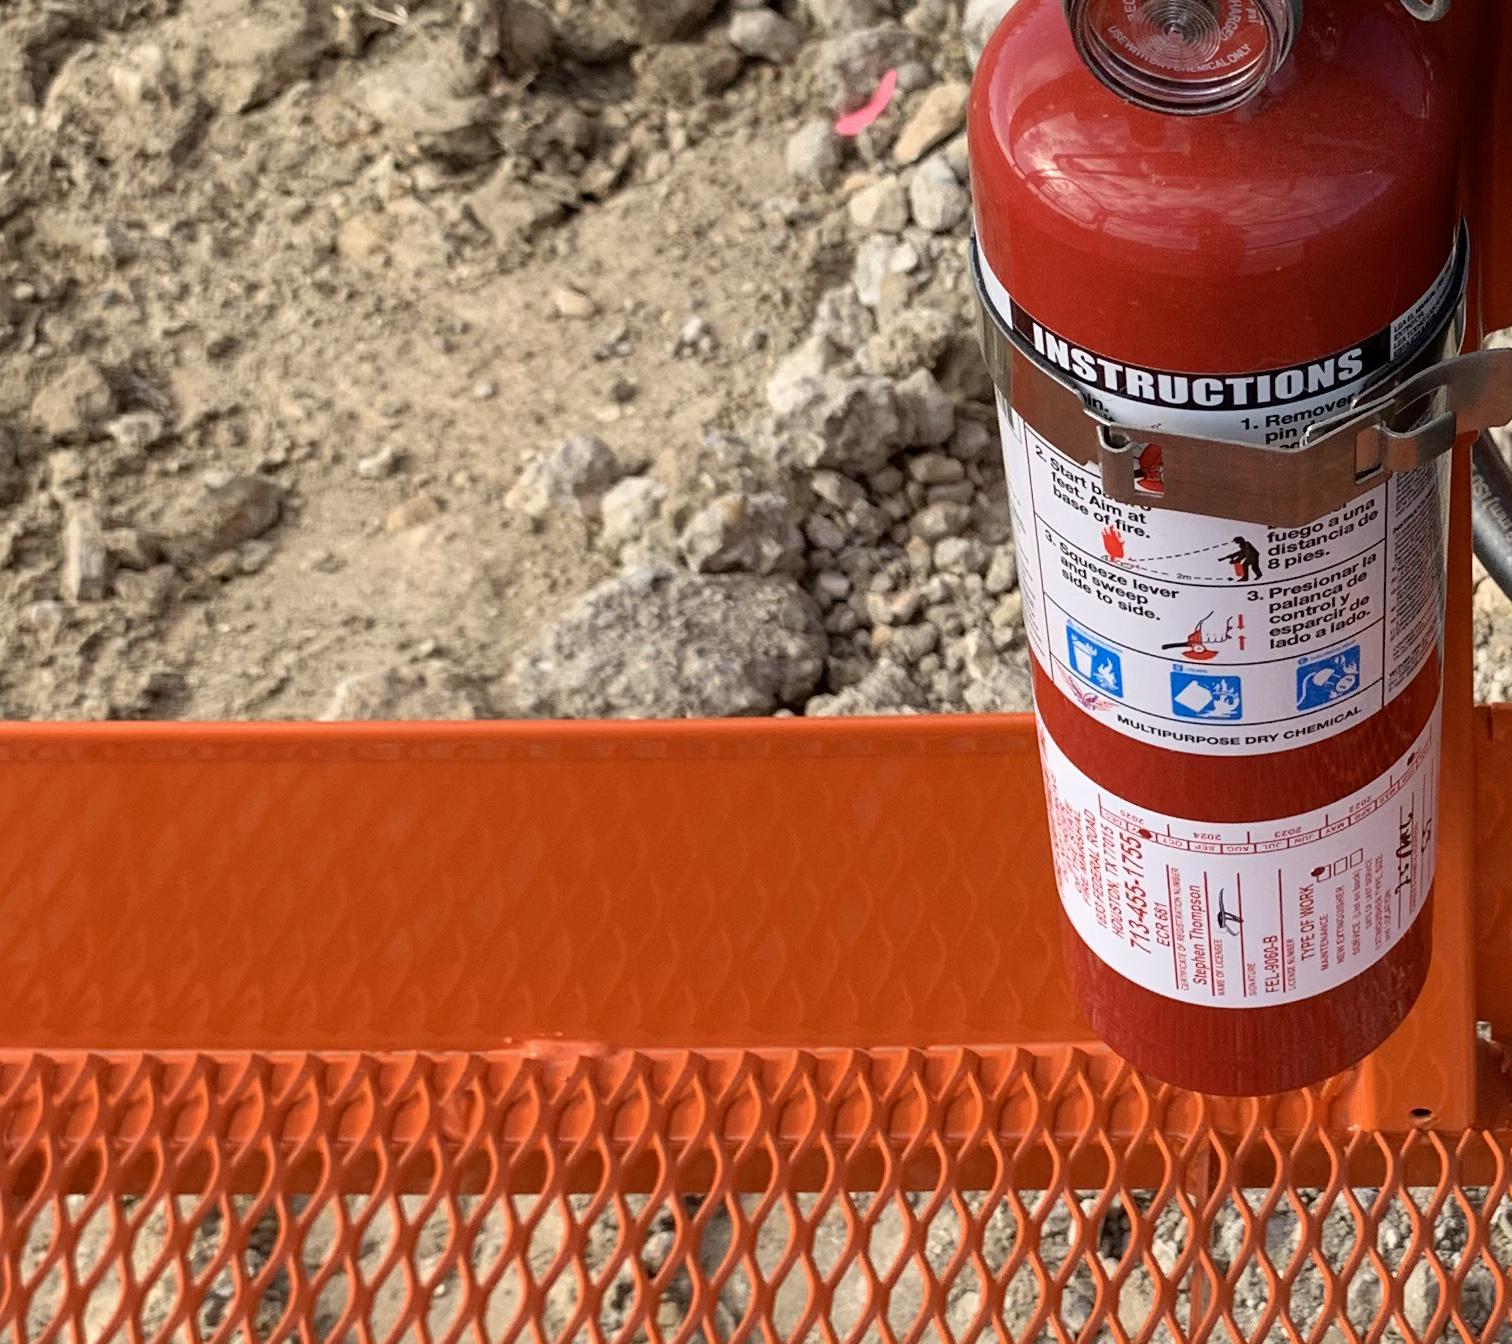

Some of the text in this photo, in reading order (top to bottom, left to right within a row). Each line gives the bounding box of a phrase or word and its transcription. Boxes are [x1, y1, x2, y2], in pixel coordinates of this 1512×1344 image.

[1107, 26, 1128, 45] USE
[1226, 43, 1252, 64] ONLY
[1032, 322, 1363, 408] INSTRUCTIONS
[1241, 418, 1259, 431] 1.
[1265, 426, 1297, 445] pin
[1035, 444, 1087, 489] 2. Start
[1051, 471, 1084, 500] feet.
[1090, 495, 1121, 517] Aim
[1128, 510, 1147, 525] at
[1052, 485, 1089, 516] base
[1093, 511, 1111, 526] of
[1114, 519, 1150, 539] fire.
[1267, 522, 1324, 544] fuego
[1328, 516, 1340, 525] a
[1343, 498, 1375, 521] una
[1267, 524, 1354, 556] distancia
[1358, 509, 1379, 528] de
[1045, 529, 1180, 599] 3. Squeeze lever
[1060, 556, 1149, 605] and sweep
[1176, 572, 1192, 580] 2m
[1247, 552, 1377, 602] 3. Presionar la
[1267, 548, 1331, 570] 8 pies.
[1062, 568, 1162, 621] side to side.
[1269, 571, 1368, 614] palanca de
[1269, 592, 1351, 624] control y
[1269, 594, 1370, 638] esparcir de
[1269, 609, 1371, 650] lado a lado.
[1117, 706, 1362, 746] MULTIPURPOSE DRY CHEMICAL
[1074, 810, 1087, 875] MARSHAL
[1083, 808, 1099, 849] ROAD
[1100, 822, 1117, 860] 77015
[1193, 832, 1221, 841] 2024
[1274, 826, 1302, 838] 2023
[1325, 822, 1345, 834] MAY
[1088, 847, 1105, 904] FEDERAL
[1104, 858, 1119, 877] TX
[1171, 867, 1181, 895] NUMBER
[1119, 831, 1152, 954] 713-455-1755
[1153, 900, 1170, 947] ECR 681
[1173, 897, 1185, 942] REGISTRATION
[1188, 885, 1210, 986] Stephen Thompson
[1299, 883, 1315, 961] TYPE OF WORK
[1335, 885, 1345, 965] NEW EXTINGUISHER
[1352, 921, 1361, 955] SERVICE
[1213, 939, 1223, 968] LICENSEE
[1263, 935, 1280, 994] FEL-9060-B
[1319, 914, 1329, 971] MAINTENANCE
[1178, 953, 1190, 991] CERTIFICATE
[1216, 977, 1225, 996] NAME
[1247, 963, 1257, 997] SIGNATURE
[1286, 938, 1297, 992] LICENSE NUMBER
